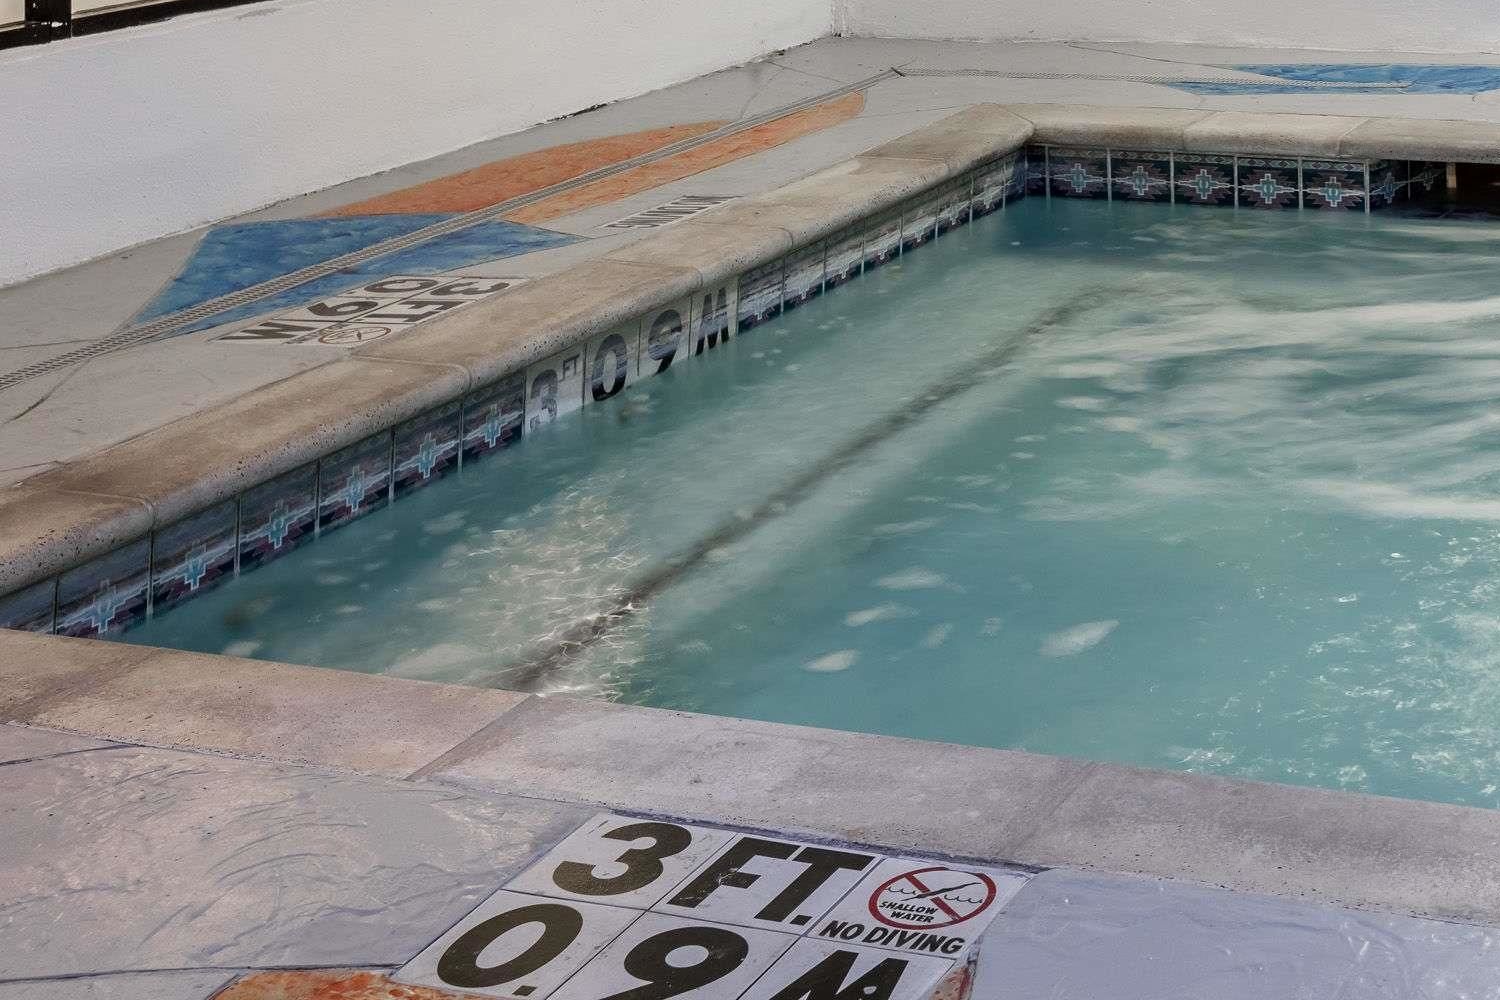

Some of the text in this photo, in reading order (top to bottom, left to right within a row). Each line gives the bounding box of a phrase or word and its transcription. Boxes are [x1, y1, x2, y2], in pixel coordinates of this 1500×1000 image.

[430, 281, 510, 296] 3
[218, 321, 320, 340] M
[695, 287, 730, 357] M
[552, 822, 876, 926] 3 FT.
[879, 900, 938, 924] SHALLOW WATER
[437, 903, 749, 1000] 0.9
[818, 919, 967, 955] NO DIVING
